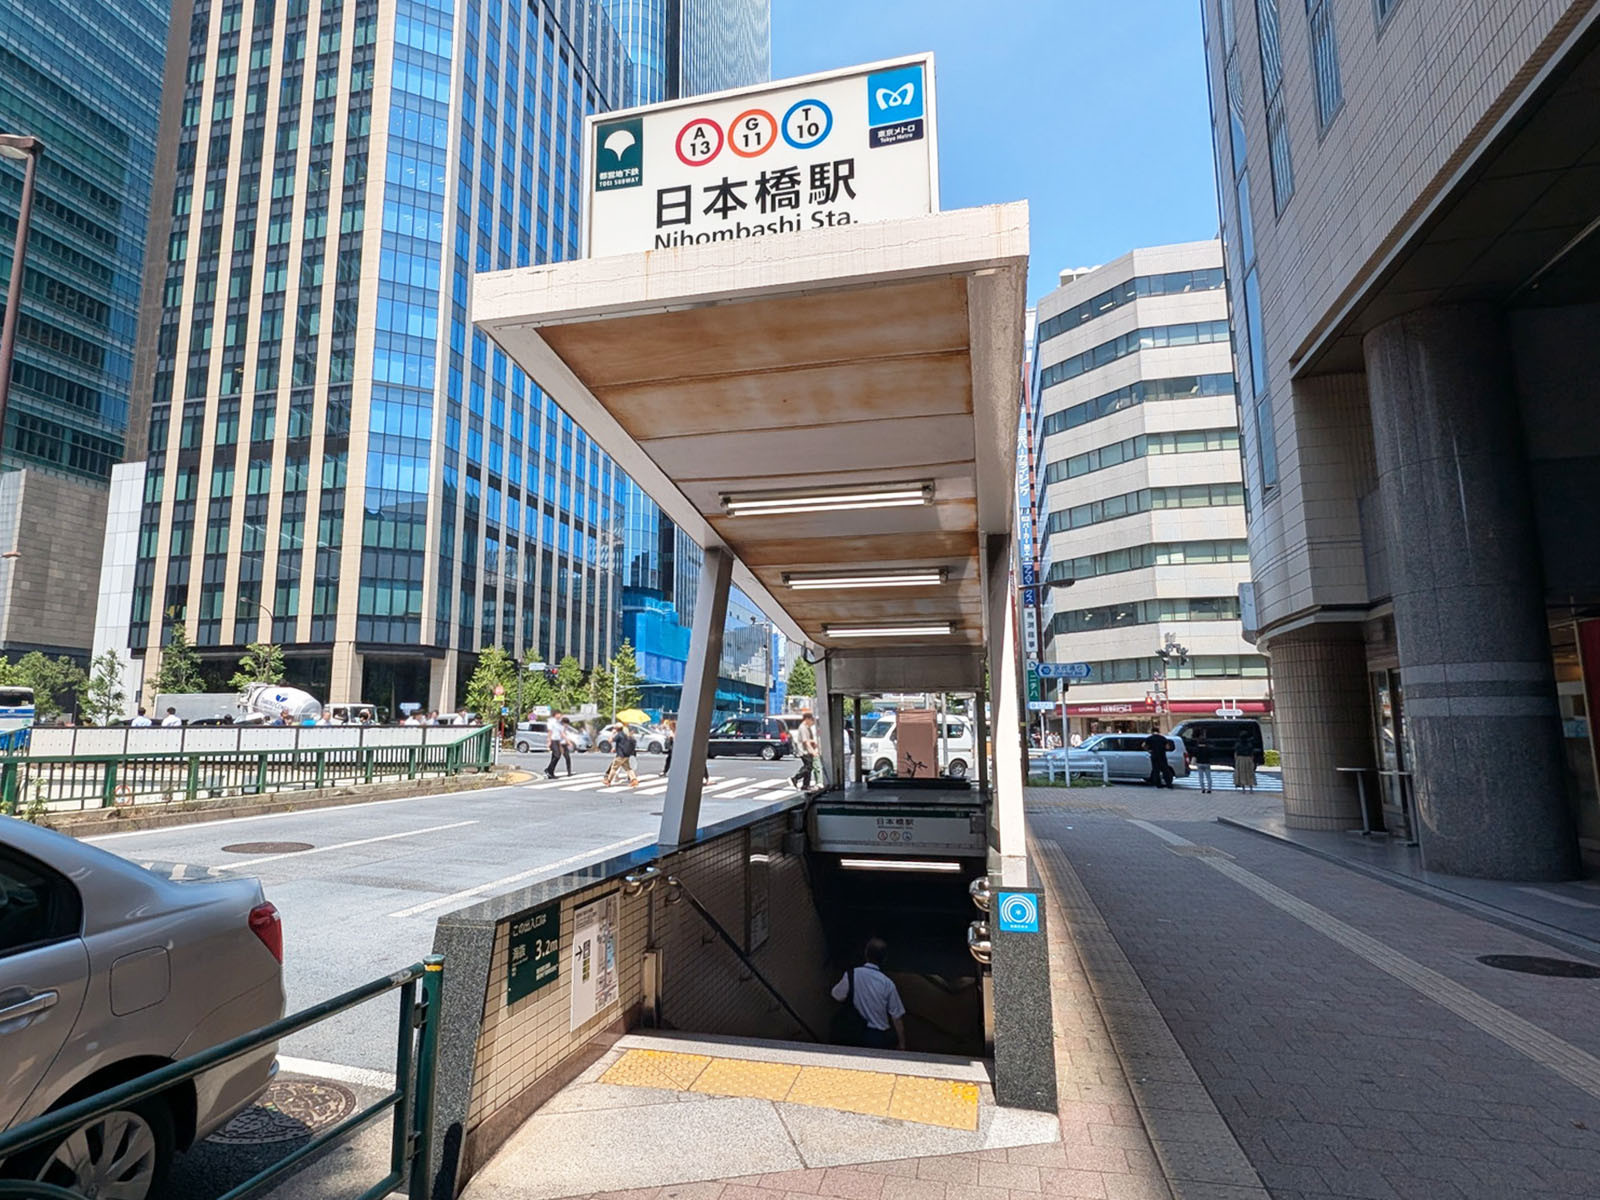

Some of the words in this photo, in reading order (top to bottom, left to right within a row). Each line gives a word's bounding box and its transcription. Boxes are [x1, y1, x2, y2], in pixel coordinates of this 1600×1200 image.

[802, 108, 812, 122] T
[745, 117, 759, 131] G
[797, 122, 820, 139] 10
[694, 127, 706, 140] A
[742, 132, 763, 148] 11
[690, 142, 711, 157] 13
[655, 158, 857, 229] 日本橋駅
[654, 214, 802, 250] Nihombashi
[810, 209, 859, 230] Sta.
[535, 939, 559, 961] 3.2m
